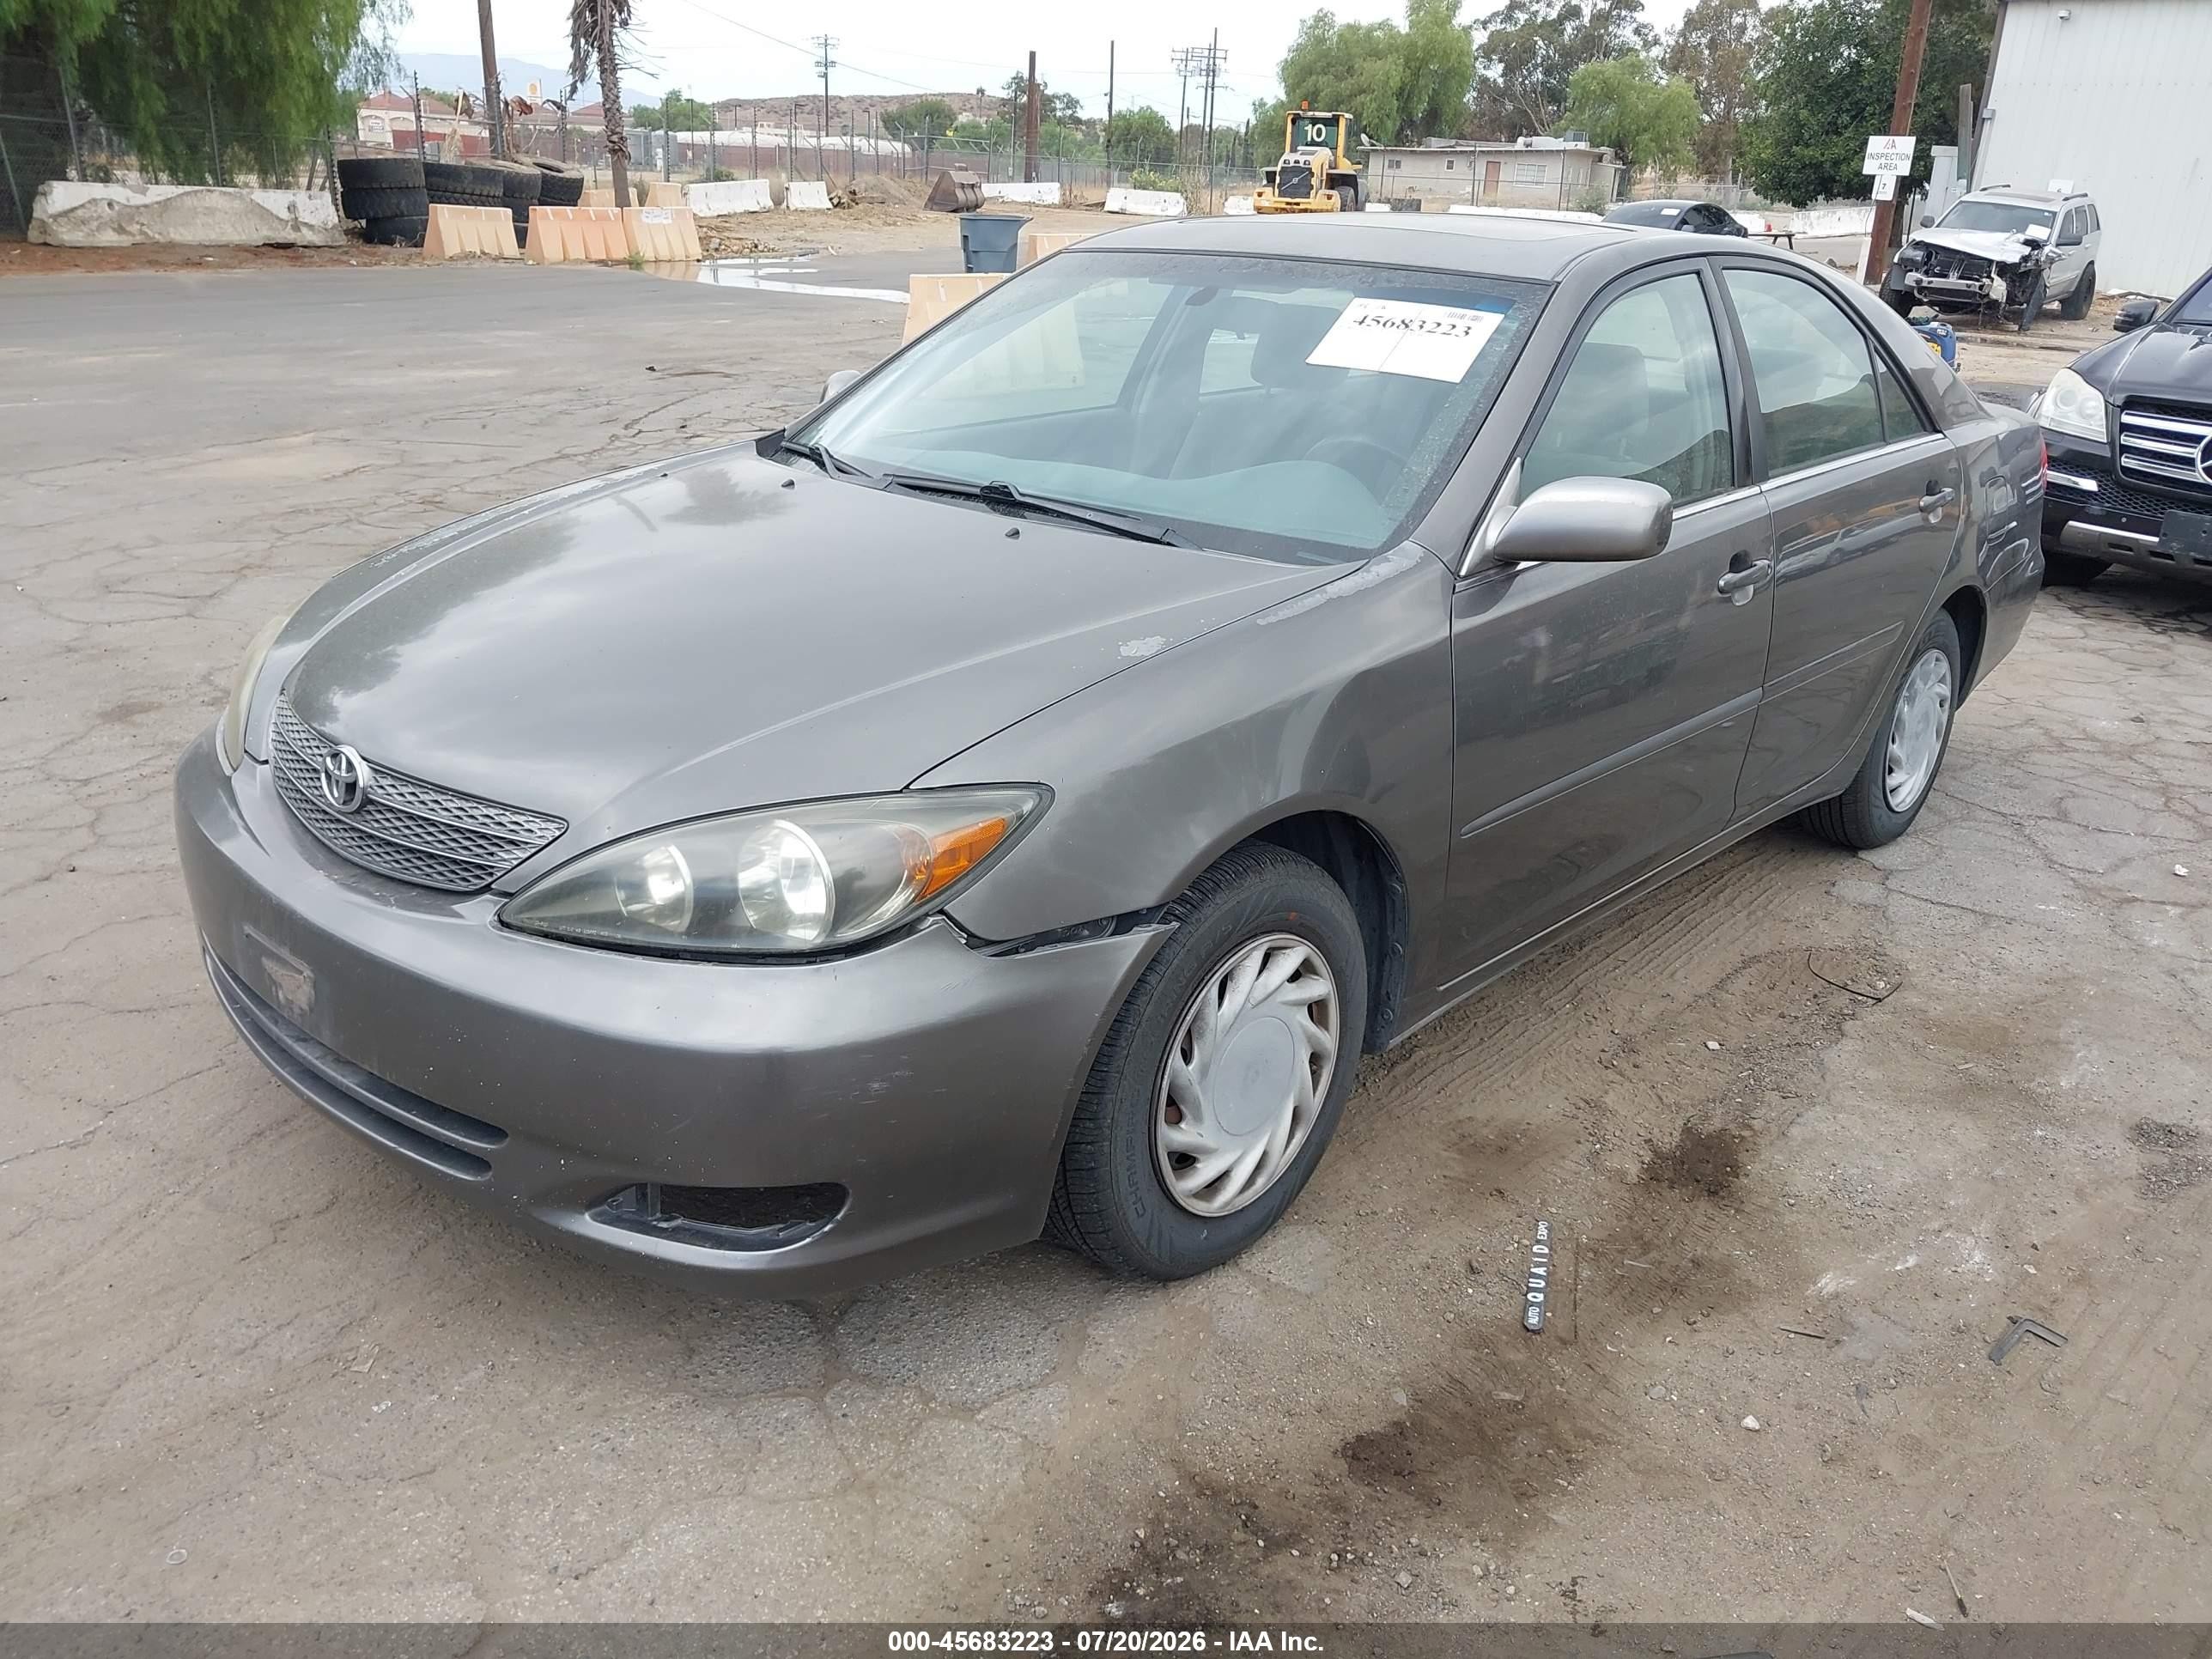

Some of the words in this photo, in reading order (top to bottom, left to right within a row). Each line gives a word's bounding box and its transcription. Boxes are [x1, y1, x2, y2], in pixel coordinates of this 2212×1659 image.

[1304, 124, 1327, 142] 10
[1867, 152, 1911, 161] INSPECTION
[1877, 162, 1899, 172] AREA
[1353, 314, 1472, 337] 45683223
[1537, 1221, 1549, 1240] EXPO
[1527, 1244, 1550, 1303] QUAID
[1528, 1306, 1540, 1325] AUTO
